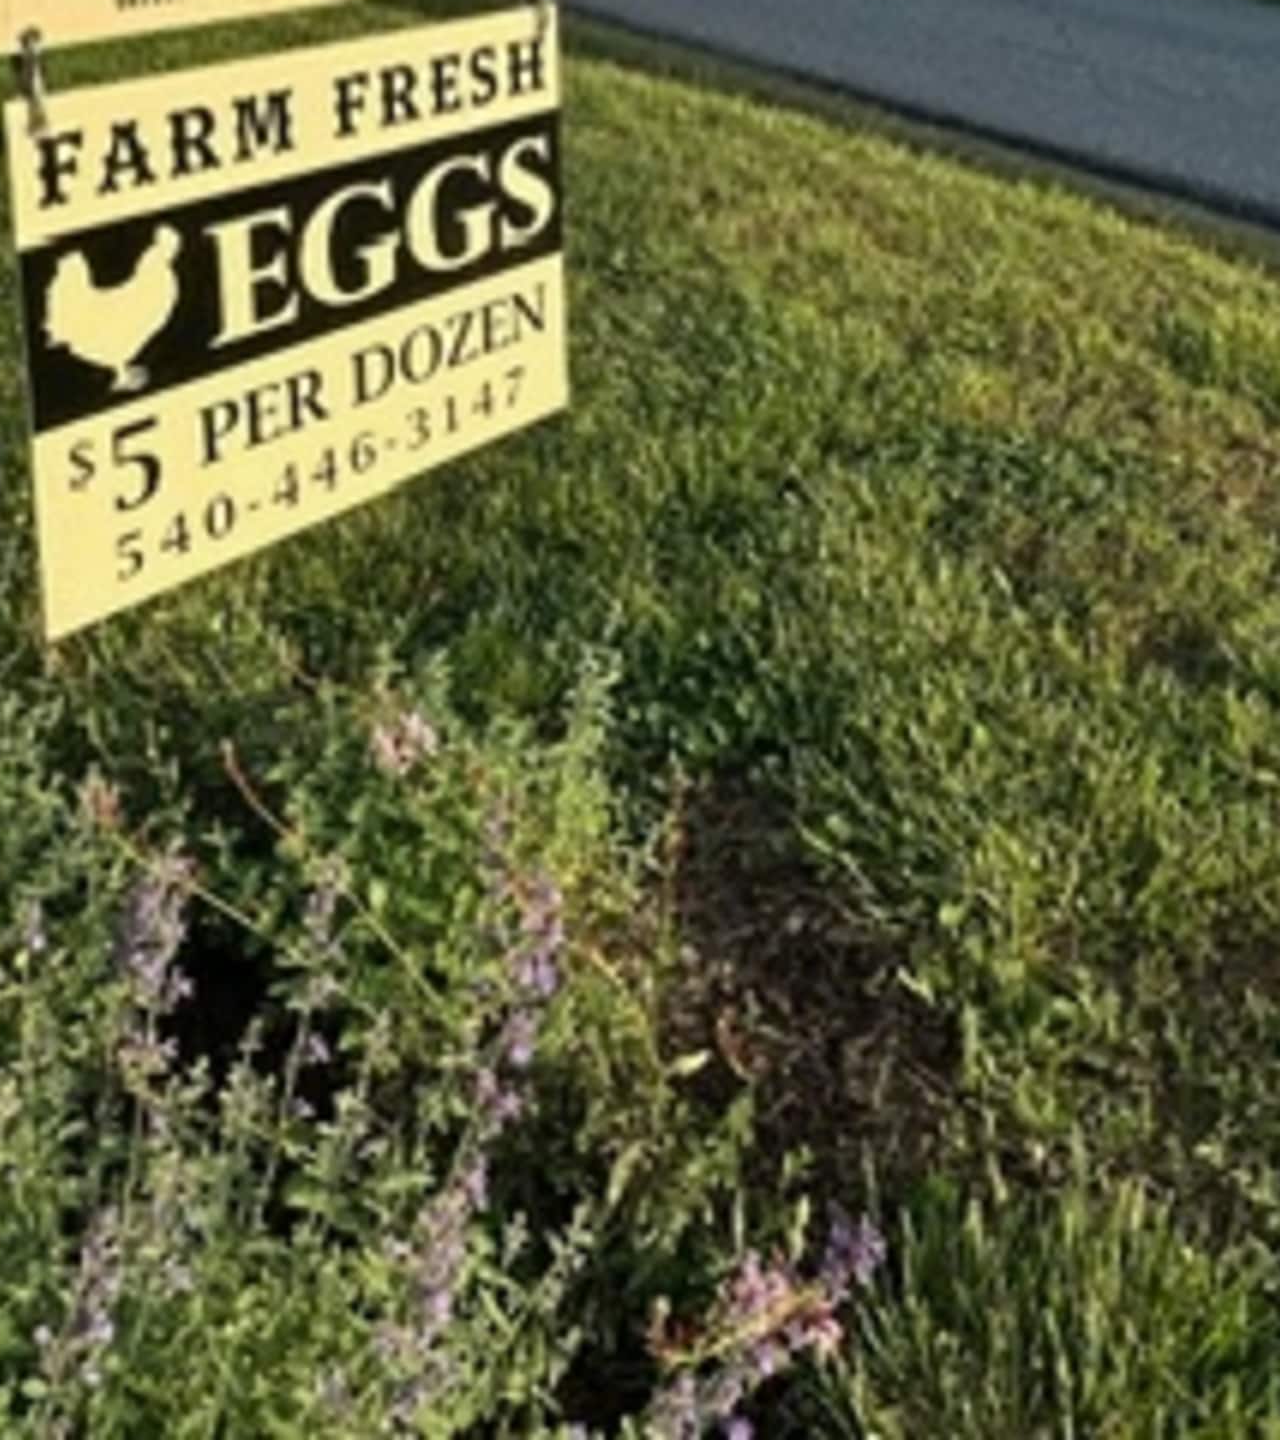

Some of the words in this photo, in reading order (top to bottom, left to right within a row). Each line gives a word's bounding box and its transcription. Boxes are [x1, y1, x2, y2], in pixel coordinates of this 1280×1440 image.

[37, 88, 295, 210] FARM
[333, 38, 546, 139] FRESH
[205, 134, 555, 350] EGGS
[66, 413, 163, 515] $5
[199, 367, 329, 468] PER
[351, 282, 547, 408] DOZEN
[114, 365, 528, 583] 540-446-3147
